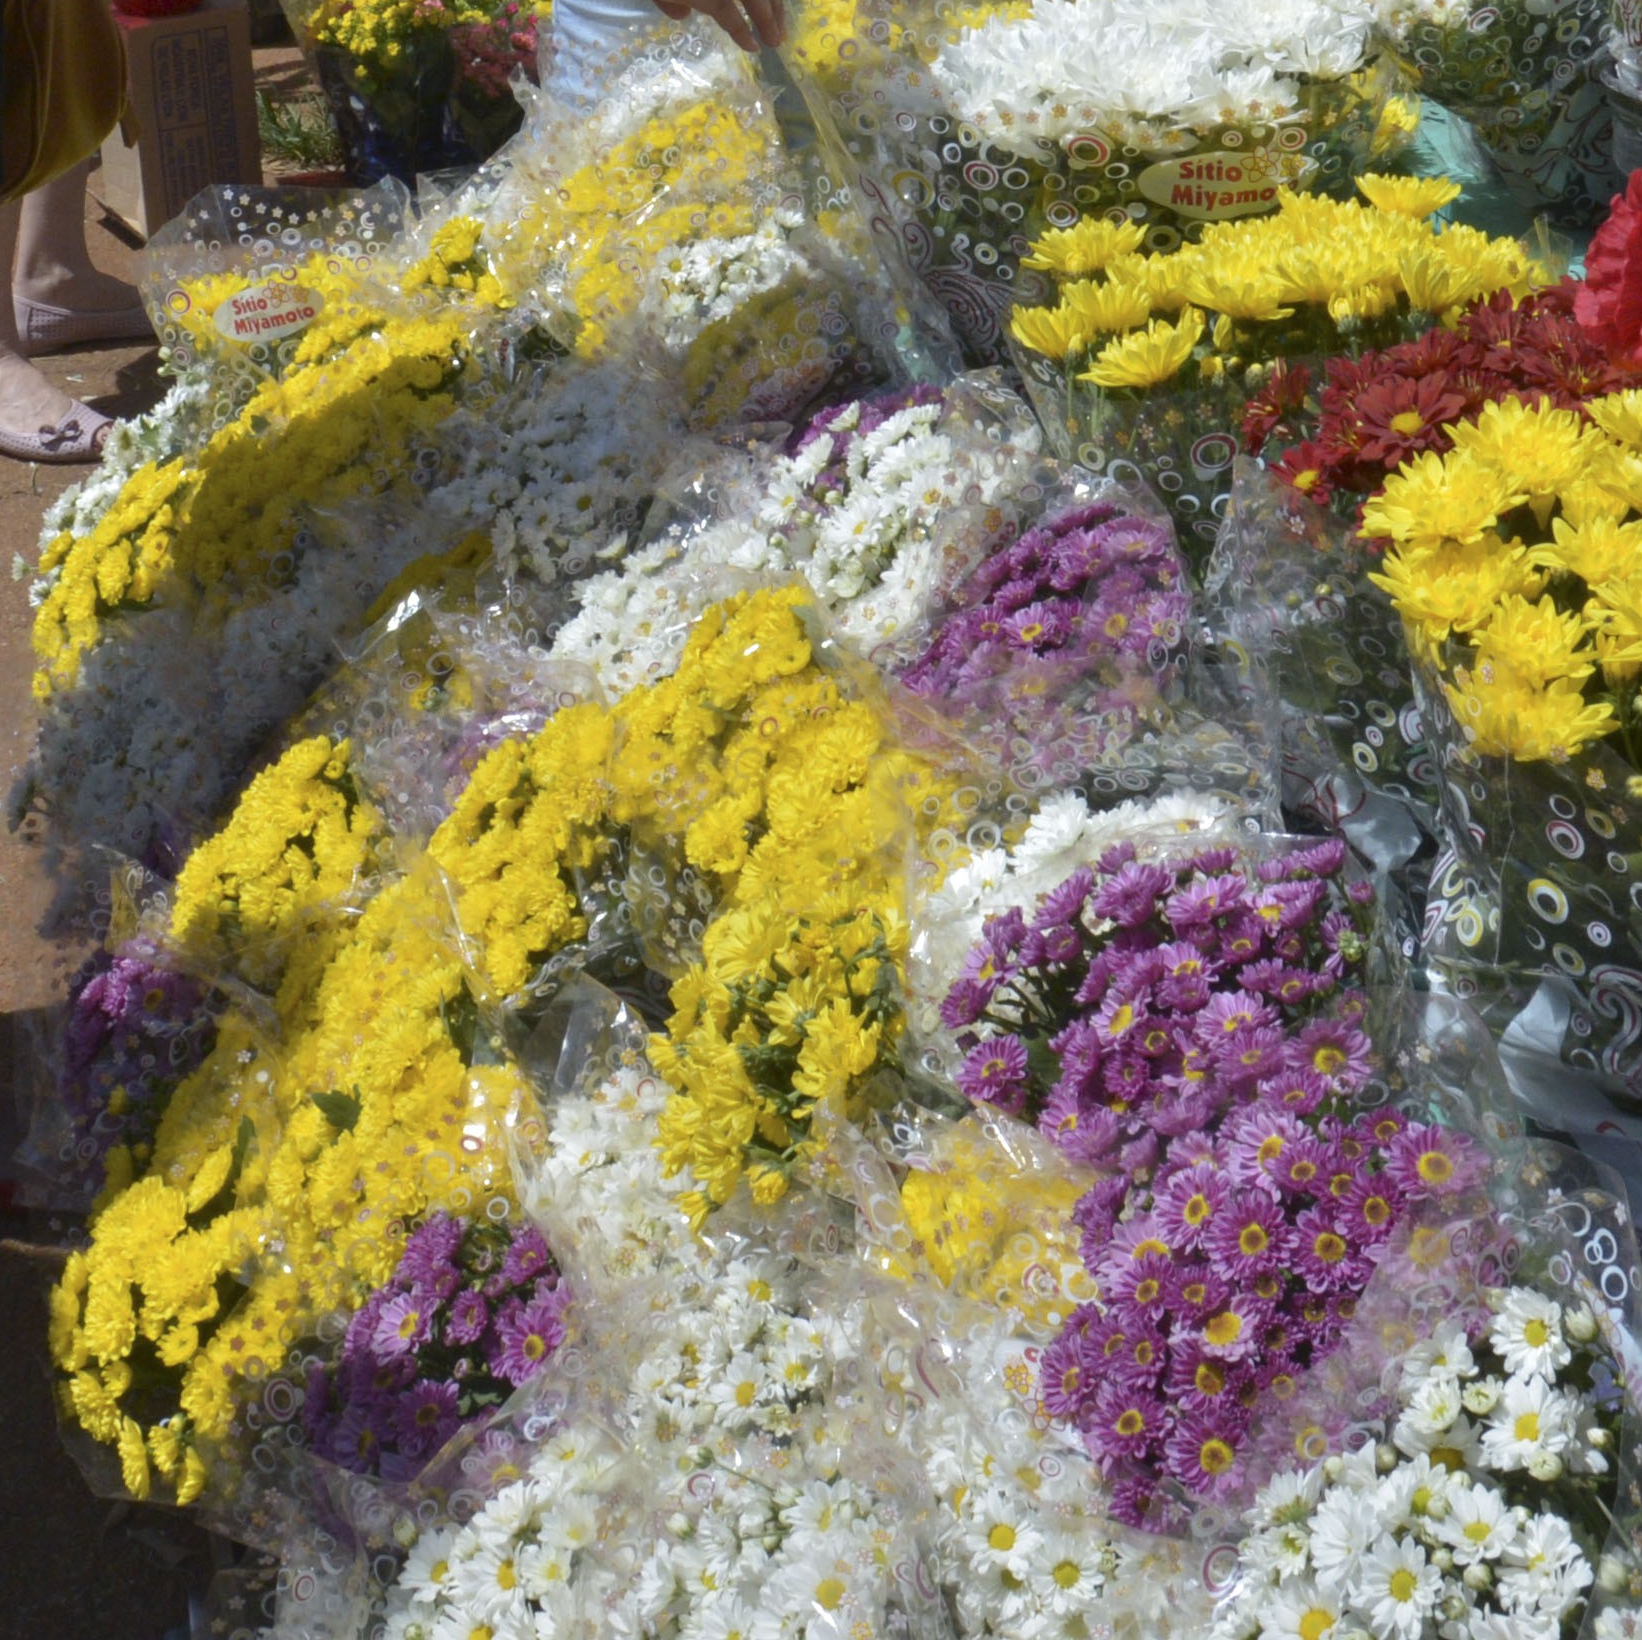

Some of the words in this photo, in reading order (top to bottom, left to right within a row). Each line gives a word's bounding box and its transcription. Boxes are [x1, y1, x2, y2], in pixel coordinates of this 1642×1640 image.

[1178, 158, 1243, 182] Sítio
[1171, 178, 1299, 211] Miyamo
[231, 295, 268, 316] Sítio
[233, 306, 316, 335] Miyamoto
